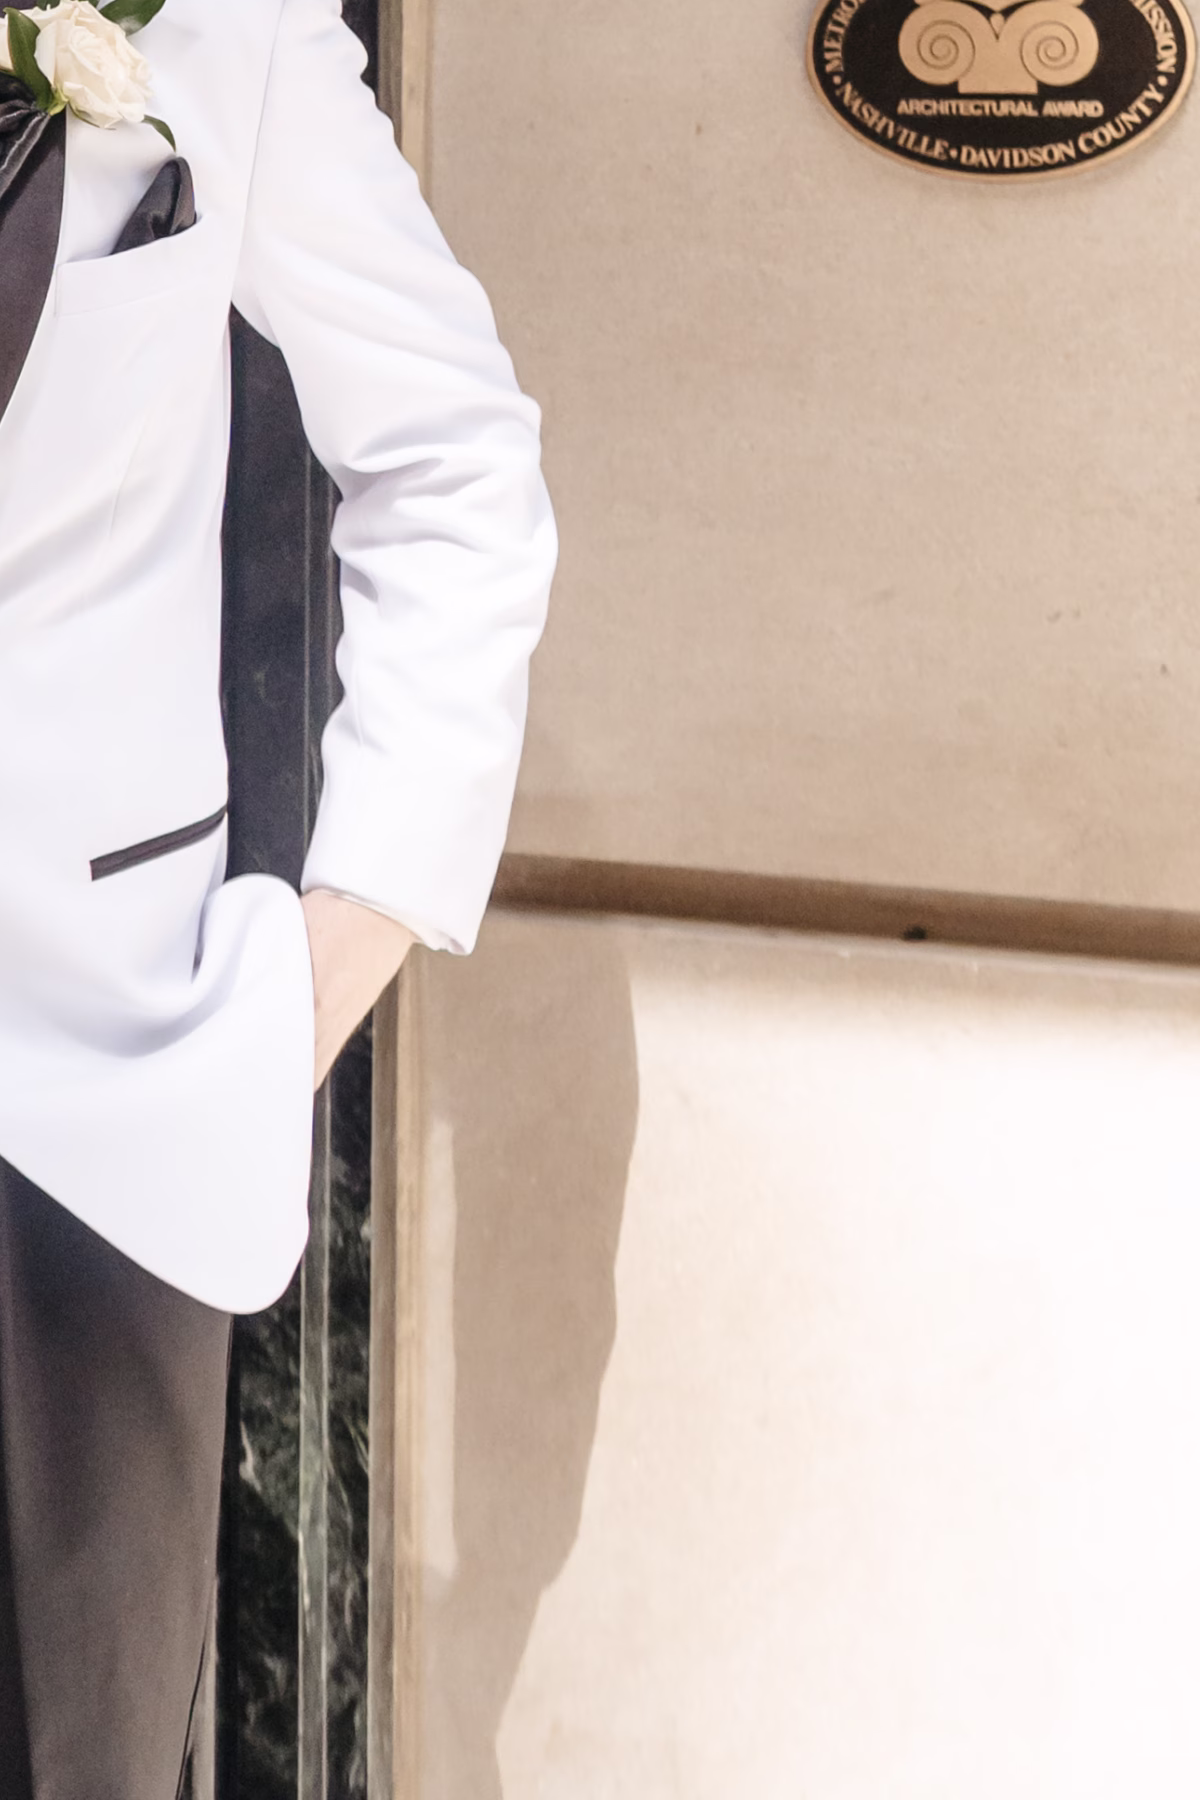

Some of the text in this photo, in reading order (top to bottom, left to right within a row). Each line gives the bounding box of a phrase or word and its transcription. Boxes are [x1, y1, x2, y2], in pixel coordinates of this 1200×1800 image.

[897, 99, 1104, 118] ARCHITECTURAL AWARD
[1077, 83, 1166, 155] COUNTY
